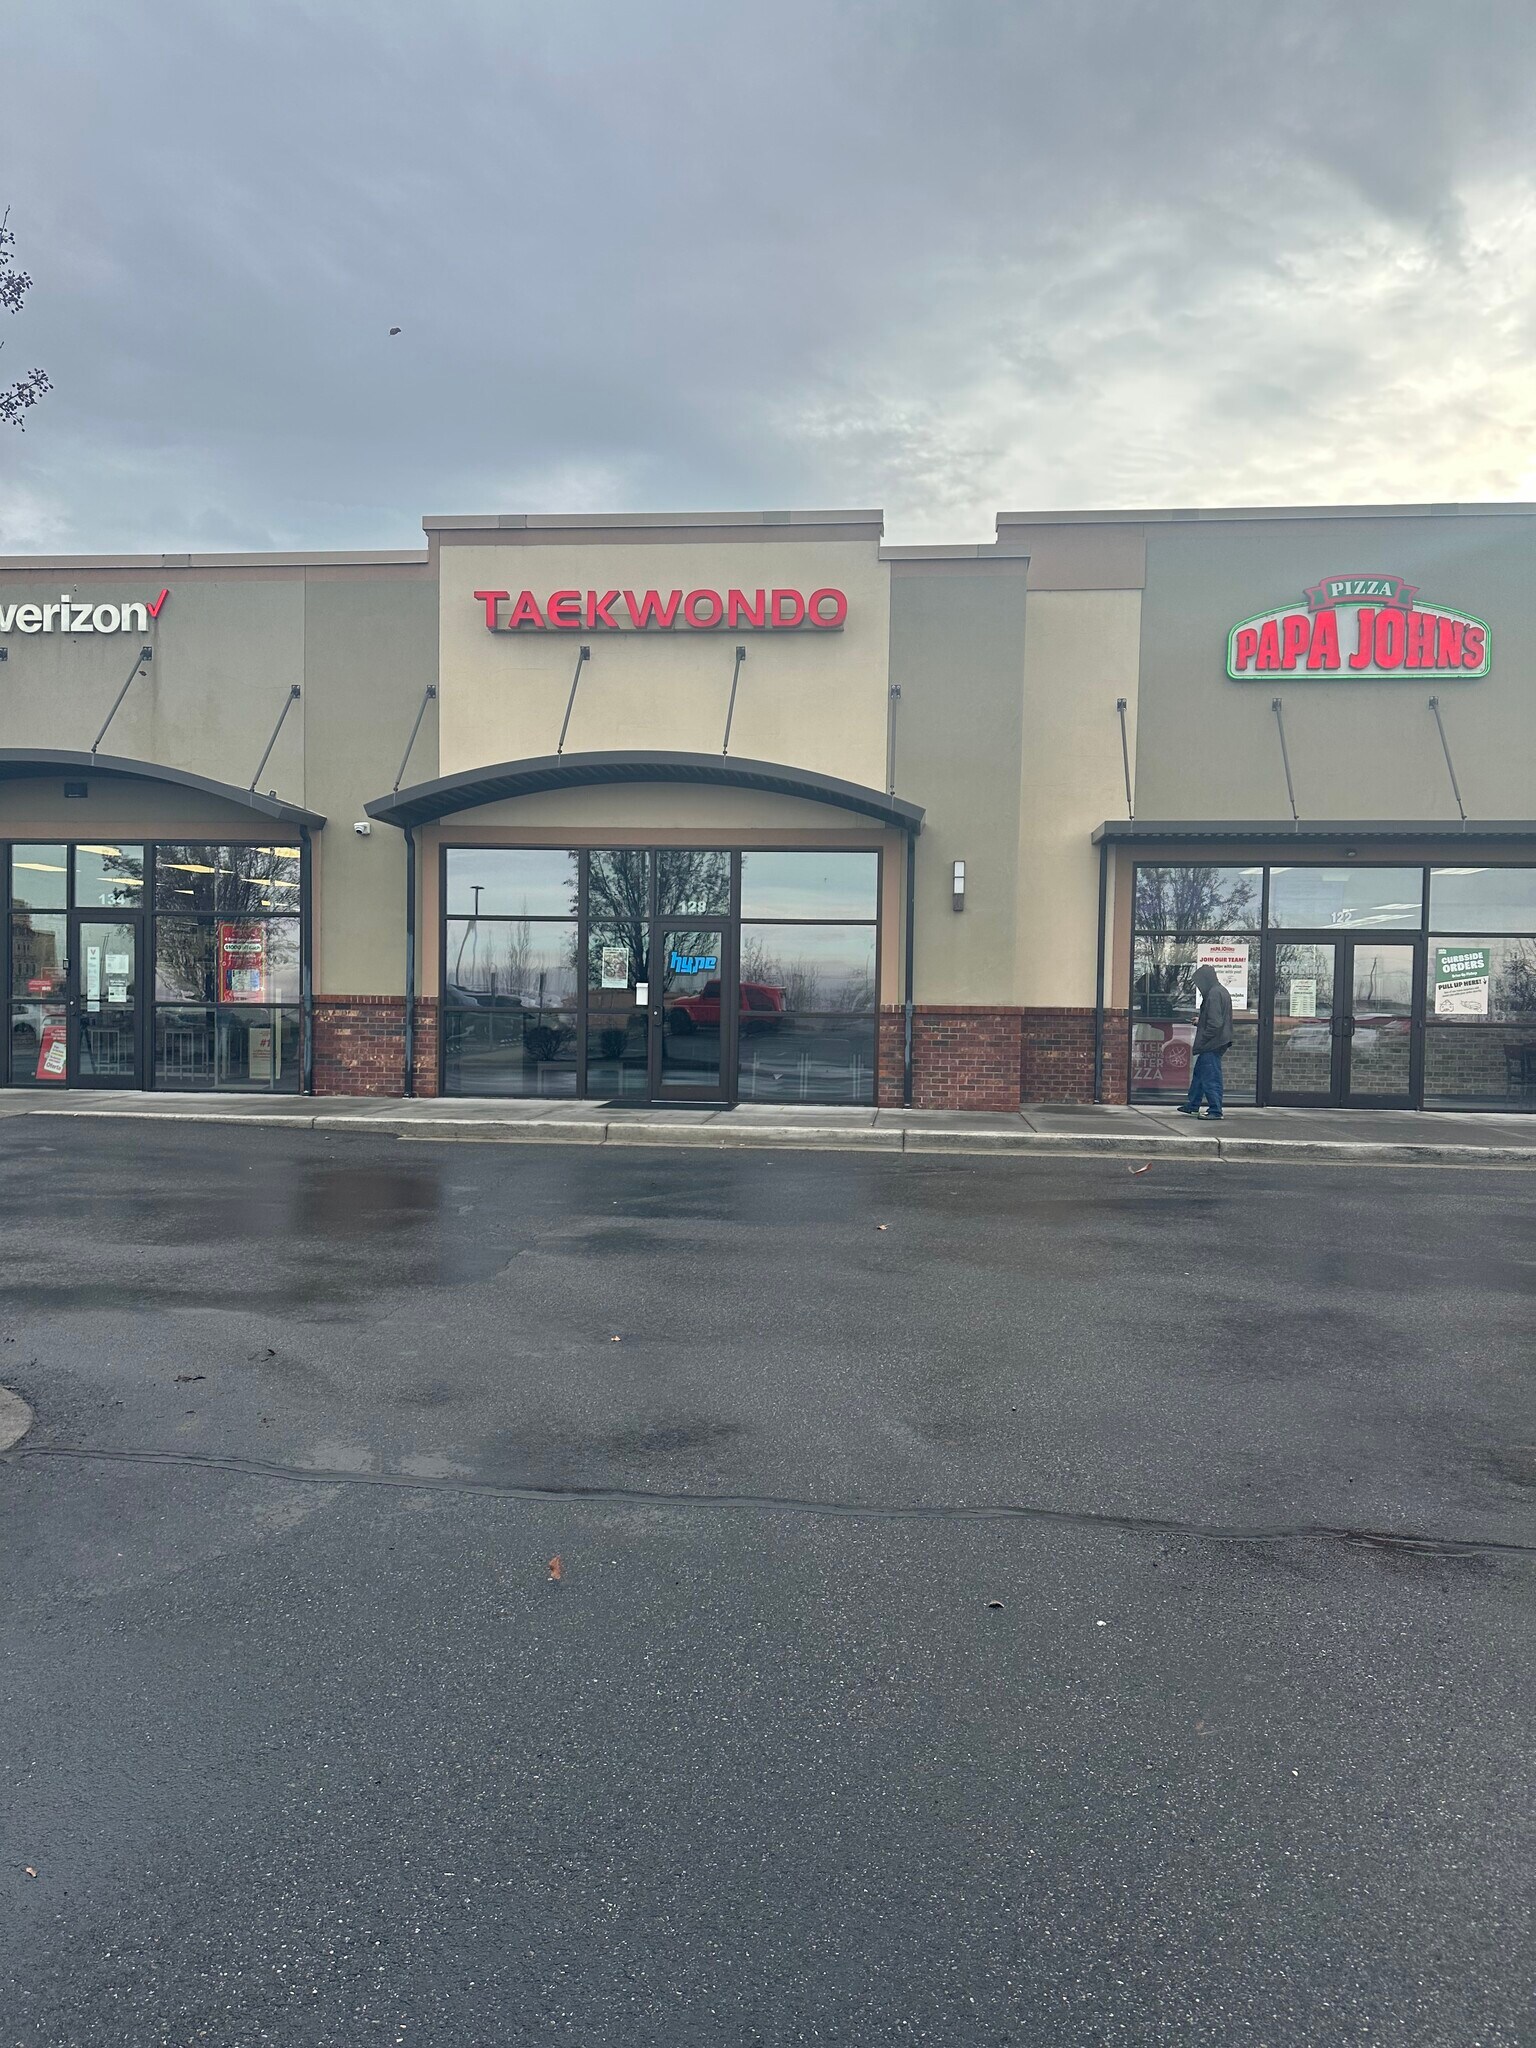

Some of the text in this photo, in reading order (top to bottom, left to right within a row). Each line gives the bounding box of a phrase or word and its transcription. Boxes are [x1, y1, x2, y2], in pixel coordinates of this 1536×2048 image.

[1330, 581, 1392, 597] PIZZA
[0, 594, 149, 634] verizon
[474, 589, 848, 630] TAEKWONDO
[1235, 610, 1341, 670] PAPA
[98, 893, 126, 905] 134
[679, 900, 707, 913] 128
[1331, 912, 1352, 923] 122
[670, 951, 718, 975] hype
[1441, 952, 1483, 964] CURBSIDE
[1442, 960, 1484, 973] ORDERS
[1134, 1042, 1164, 1052] TTER
[1134, 1058, 1164, 1068] TTER
[1133, 1067, 1164, 1080] ZZA
